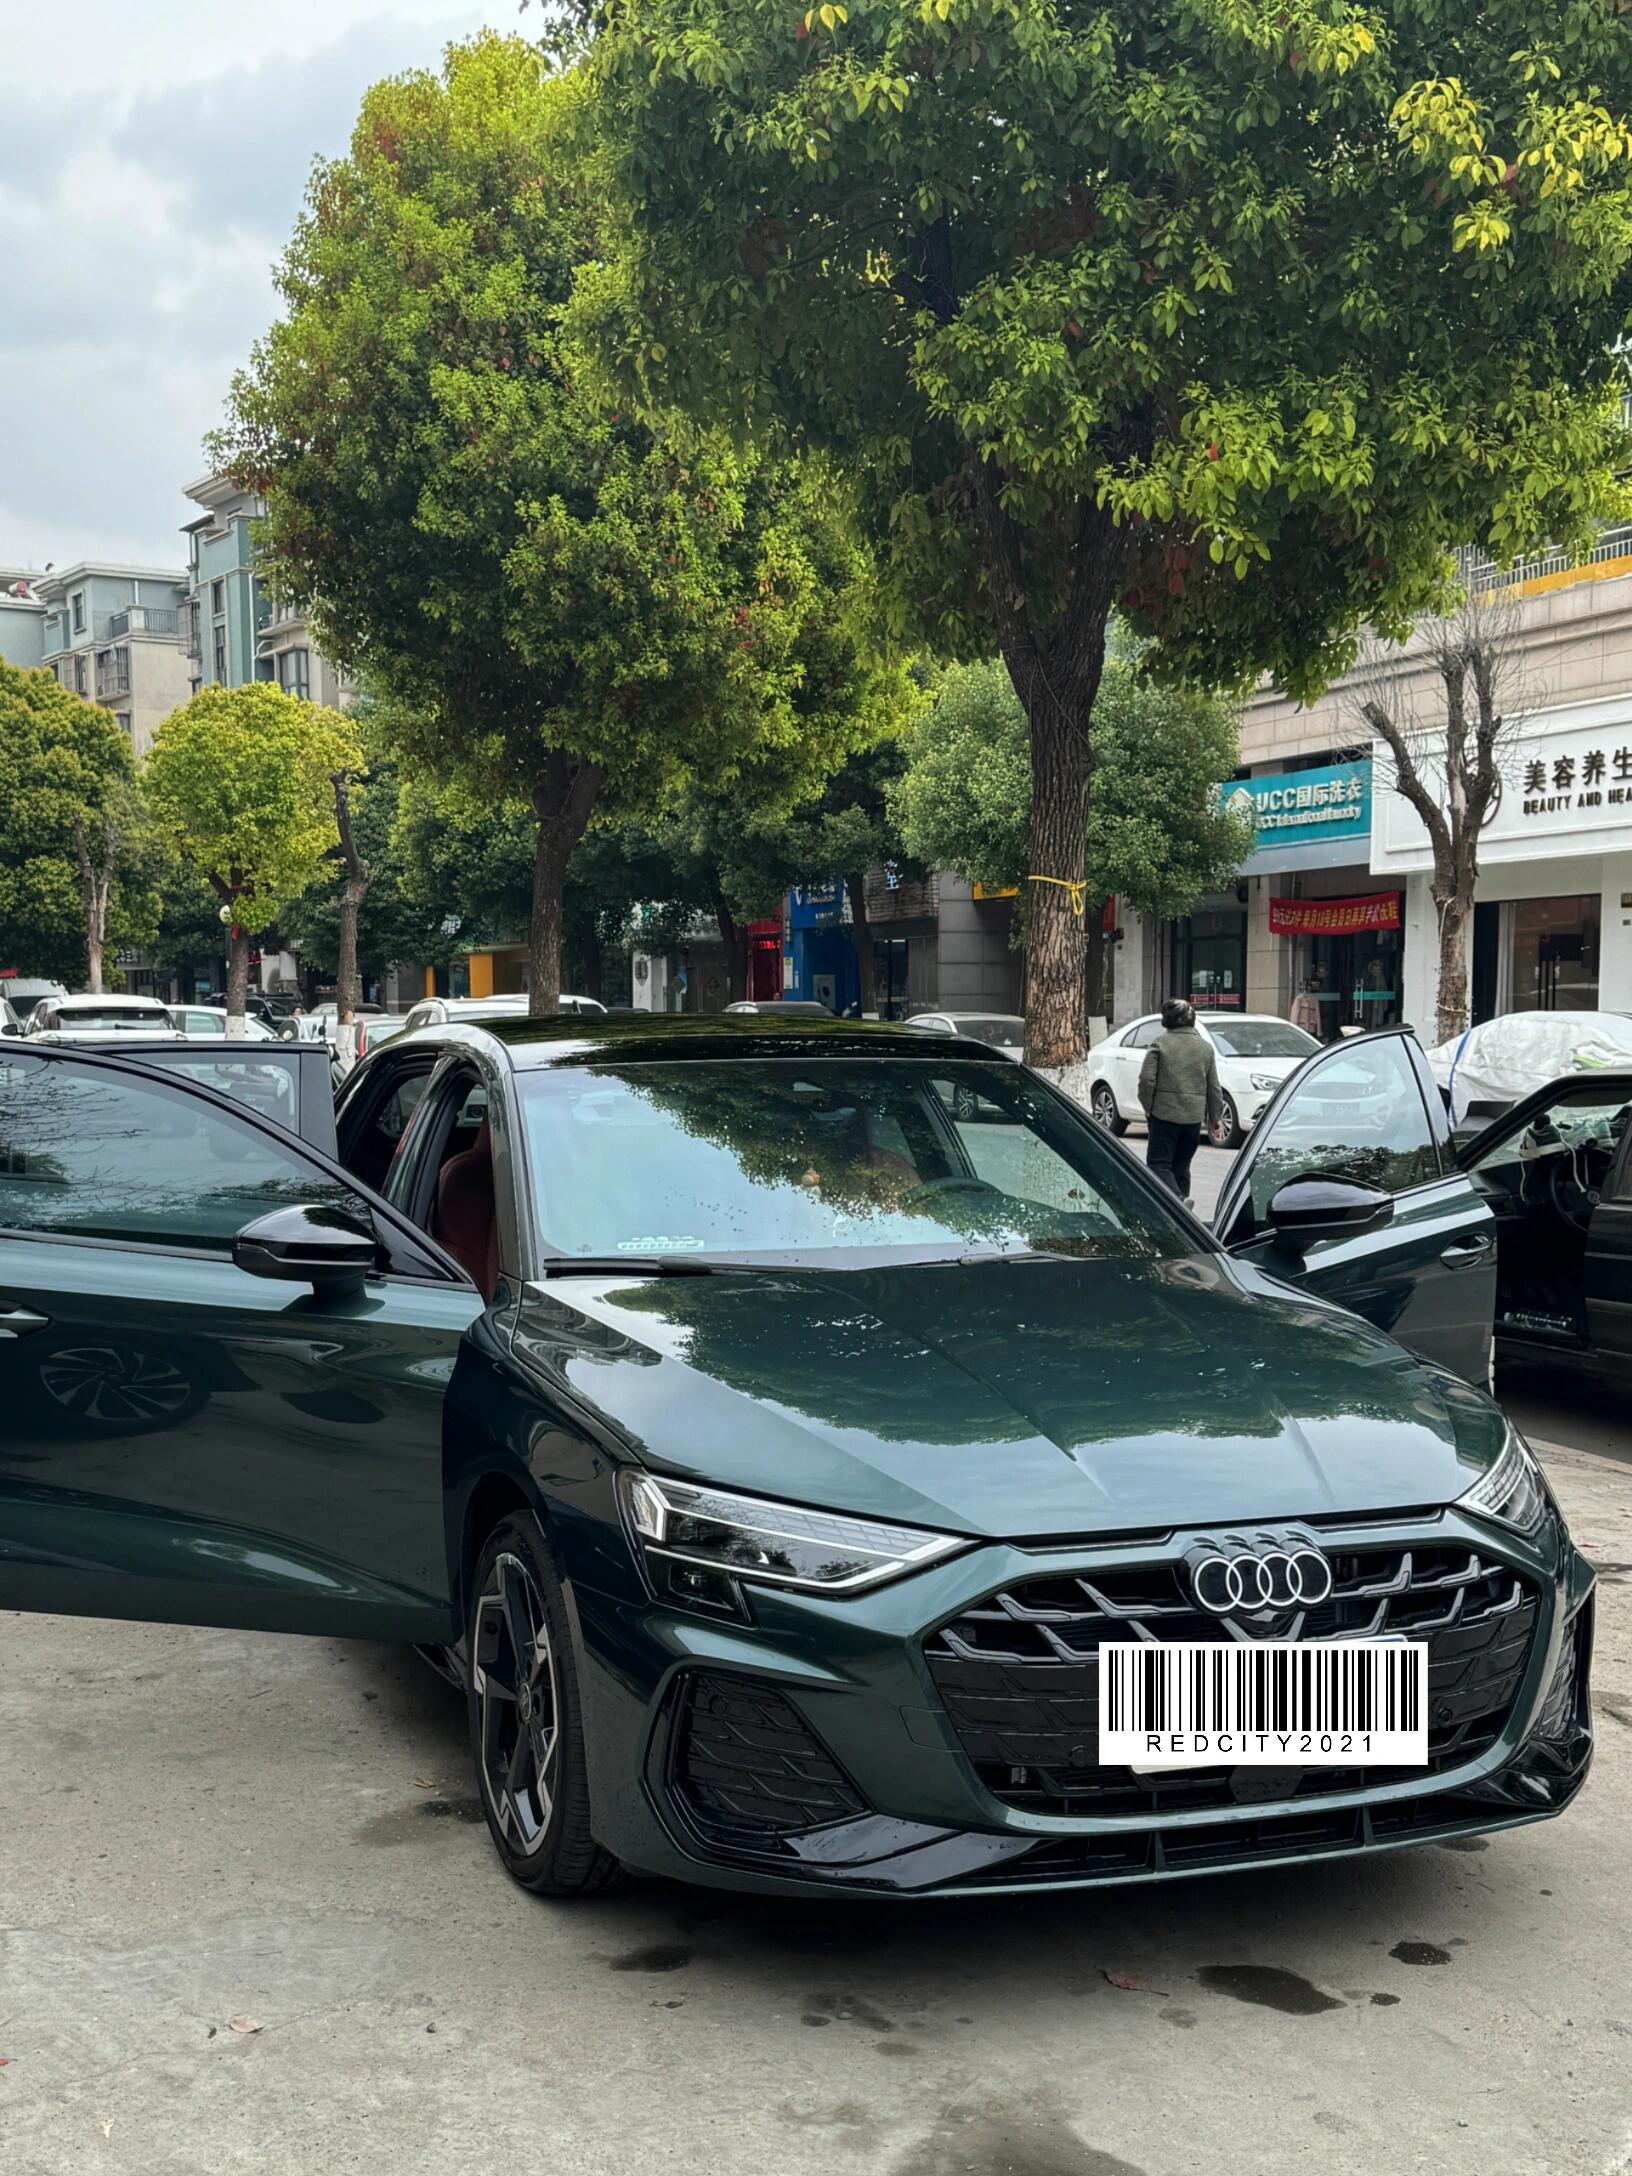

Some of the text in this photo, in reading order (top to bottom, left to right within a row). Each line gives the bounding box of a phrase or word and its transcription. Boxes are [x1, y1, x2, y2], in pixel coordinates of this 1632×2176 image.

[1523, 746, 1632, 795] 美容养生
[1523, 795, 1572, 816] BEAUTY
[1577, 791, 1602, 808] AND
